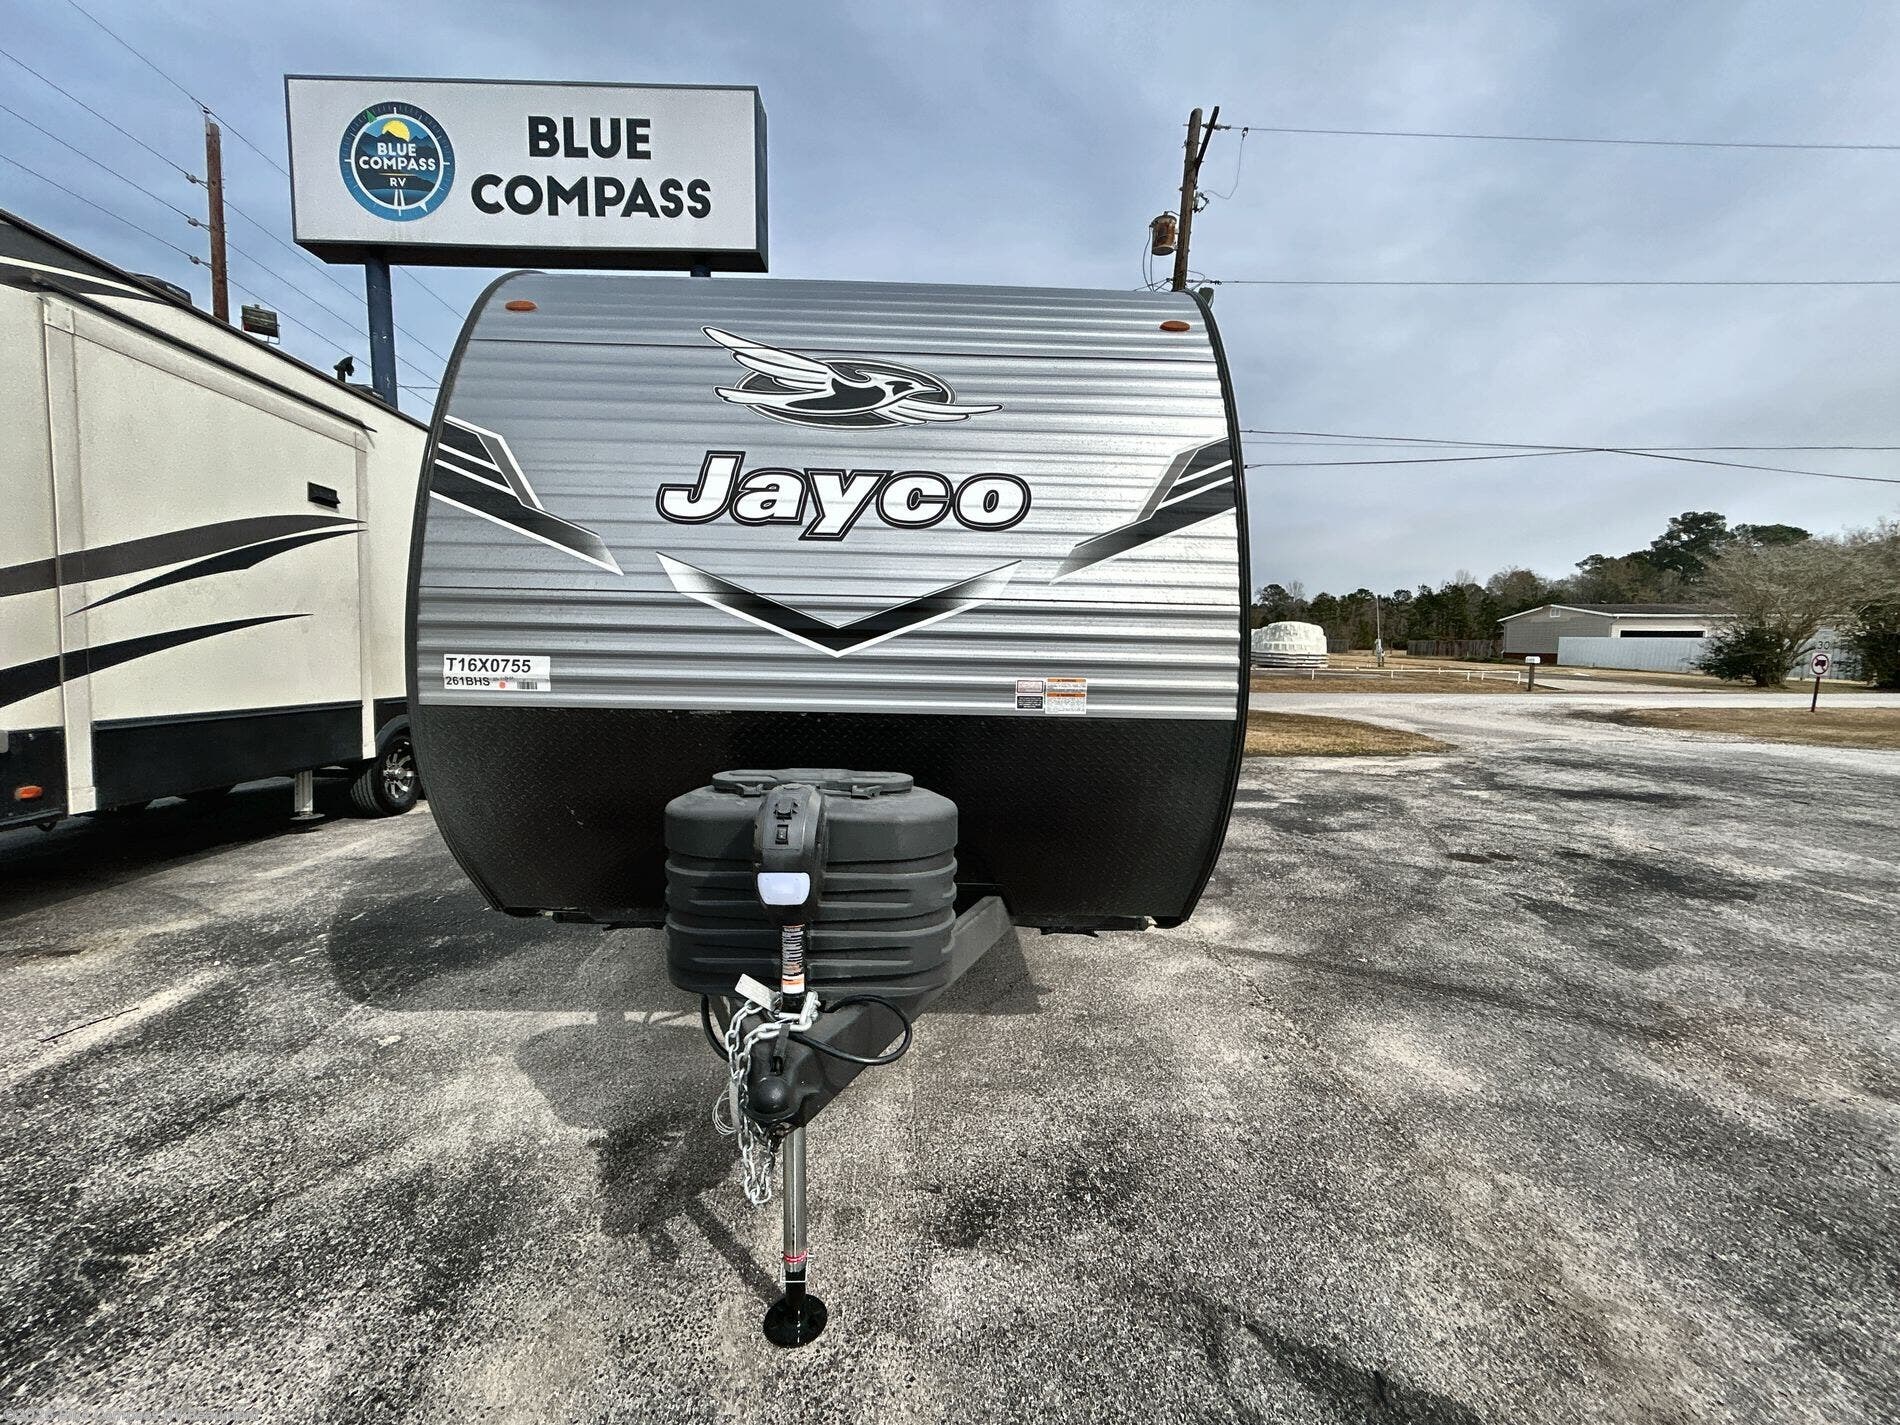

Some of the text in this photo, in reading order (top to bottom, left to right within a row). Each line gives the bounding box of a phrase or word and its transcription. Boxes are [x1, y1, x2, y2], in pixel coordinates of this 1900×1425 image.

[528, 115, 652, 160] BLUE
[377, 142, 417, 157] BLUE
[359, 156, 436, 171] COMPASS
[389, 177, 406, 187] RV
[471, 174, 712, 219] COMPASS
[656, 450, 1032, 542] Jayco
[446, 657, 531, 673] T16X0755
[445, 676, 491, 686] 261BHS
